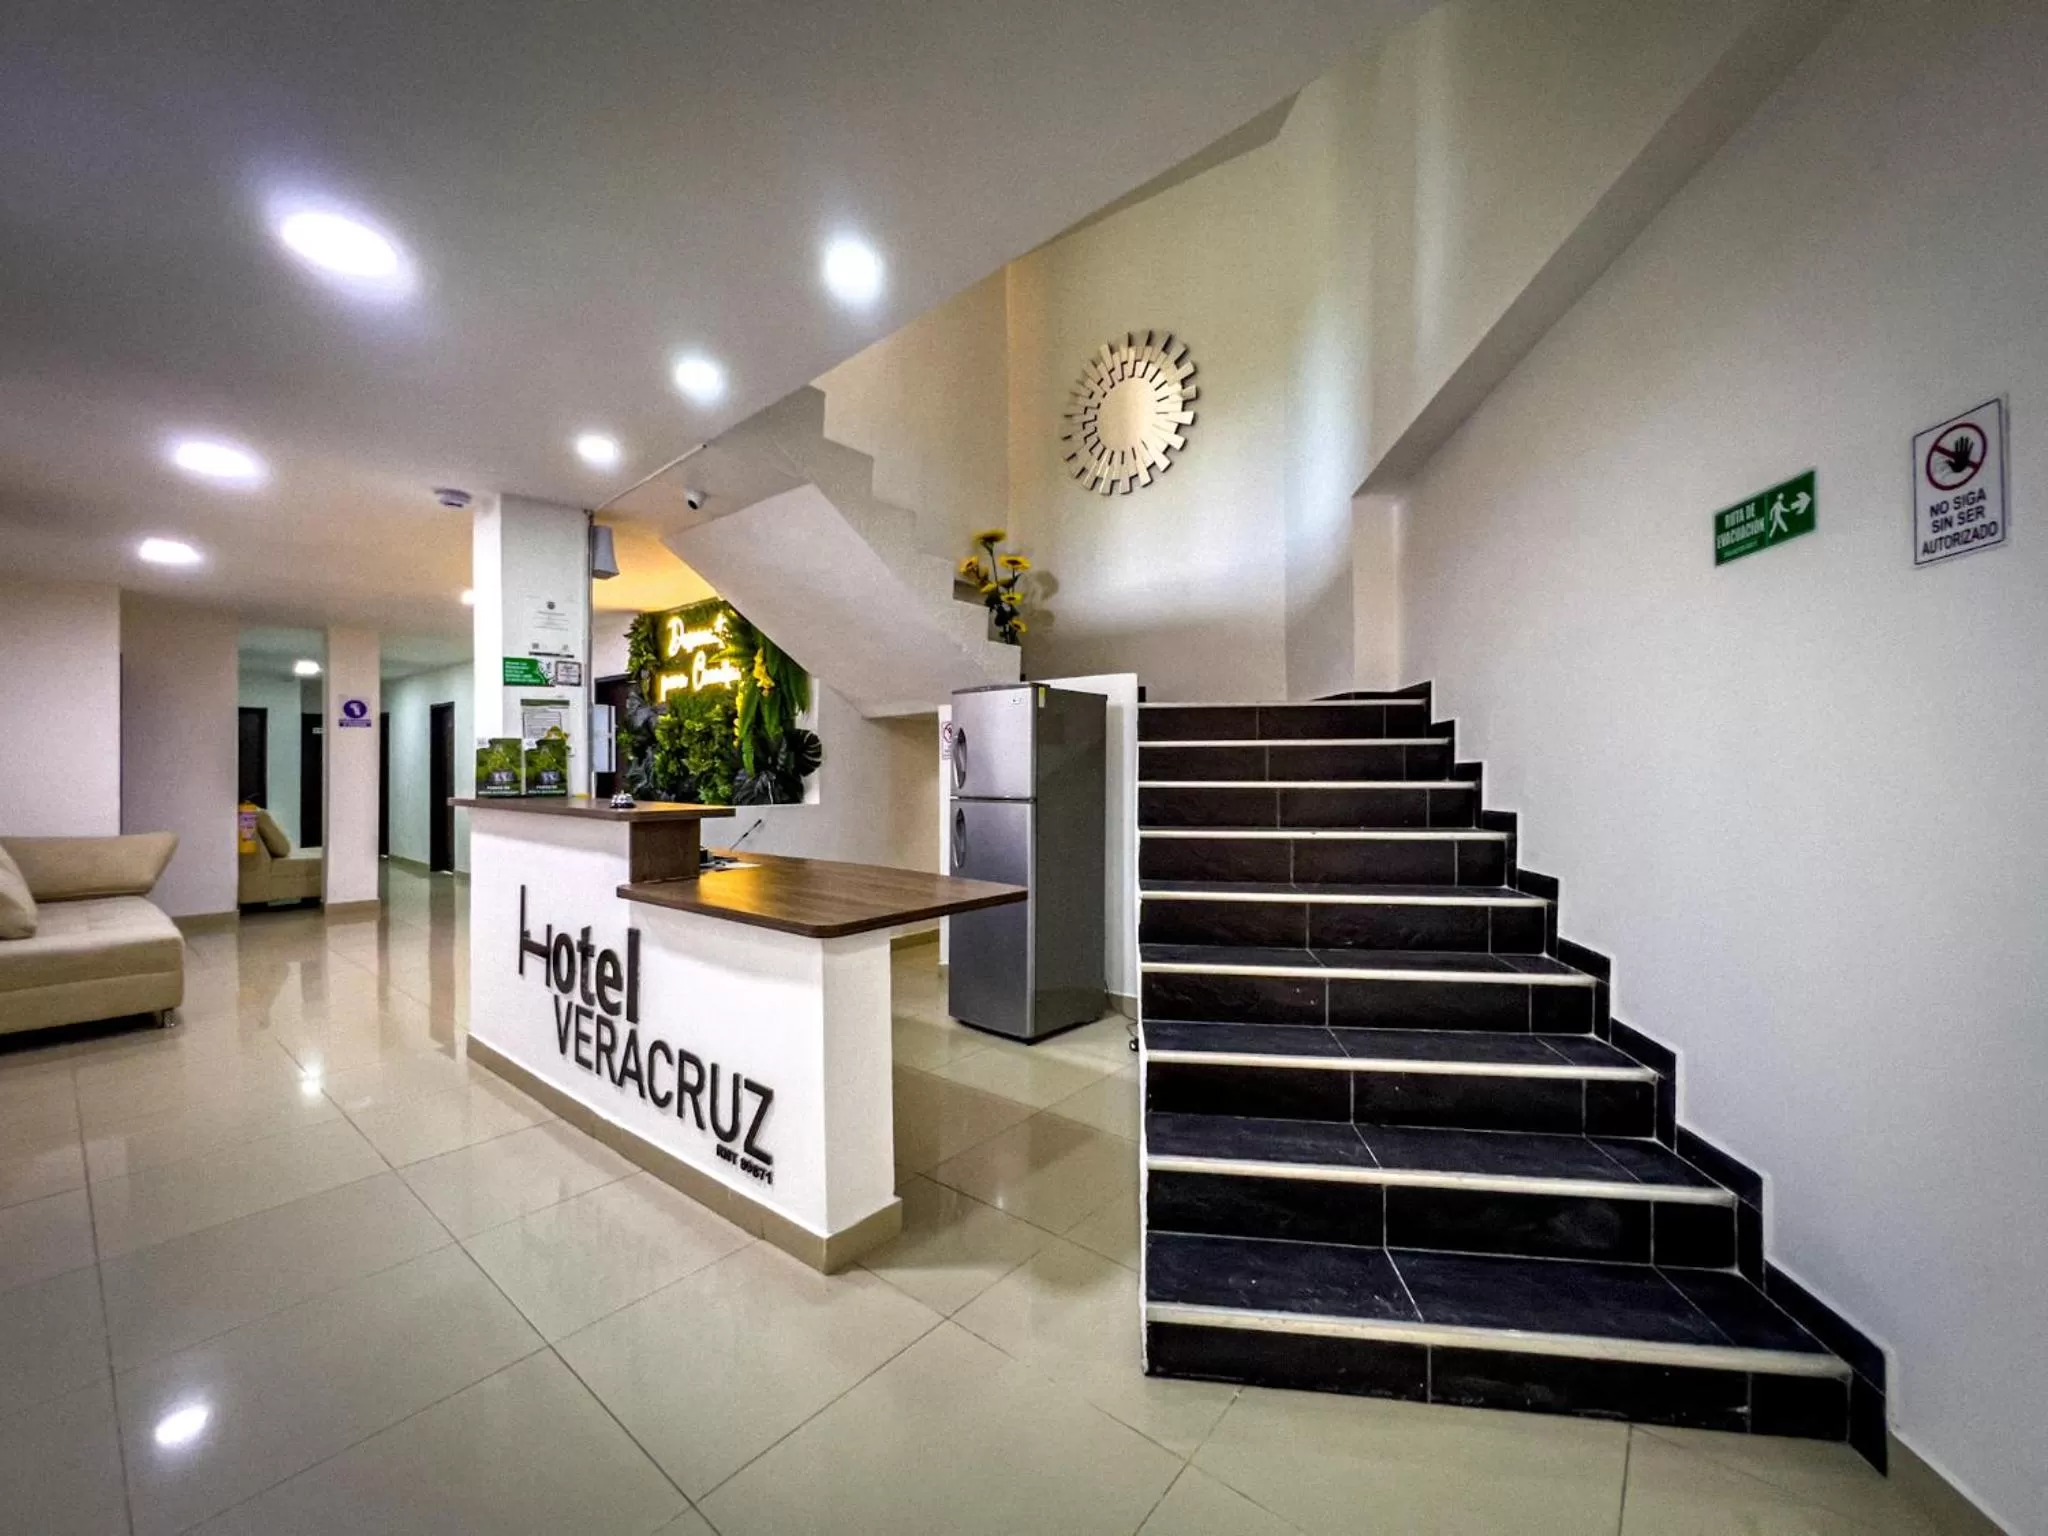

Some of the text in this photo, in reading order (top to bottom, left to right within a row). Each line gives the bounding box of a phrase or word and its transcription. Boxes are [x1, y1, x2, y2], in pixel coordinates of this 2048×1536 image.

[1745, 502, 1756, 520] DE
[1930, 488, 1986, 517] NO SIGA
[1932, 505, 1985, 533] SIN SER
[1922, 521, 1998, 555] AUTORIZADO
[518, 884, 641, 1024] Hotel
[554, 995, 775, 1166] VERACRUZ
